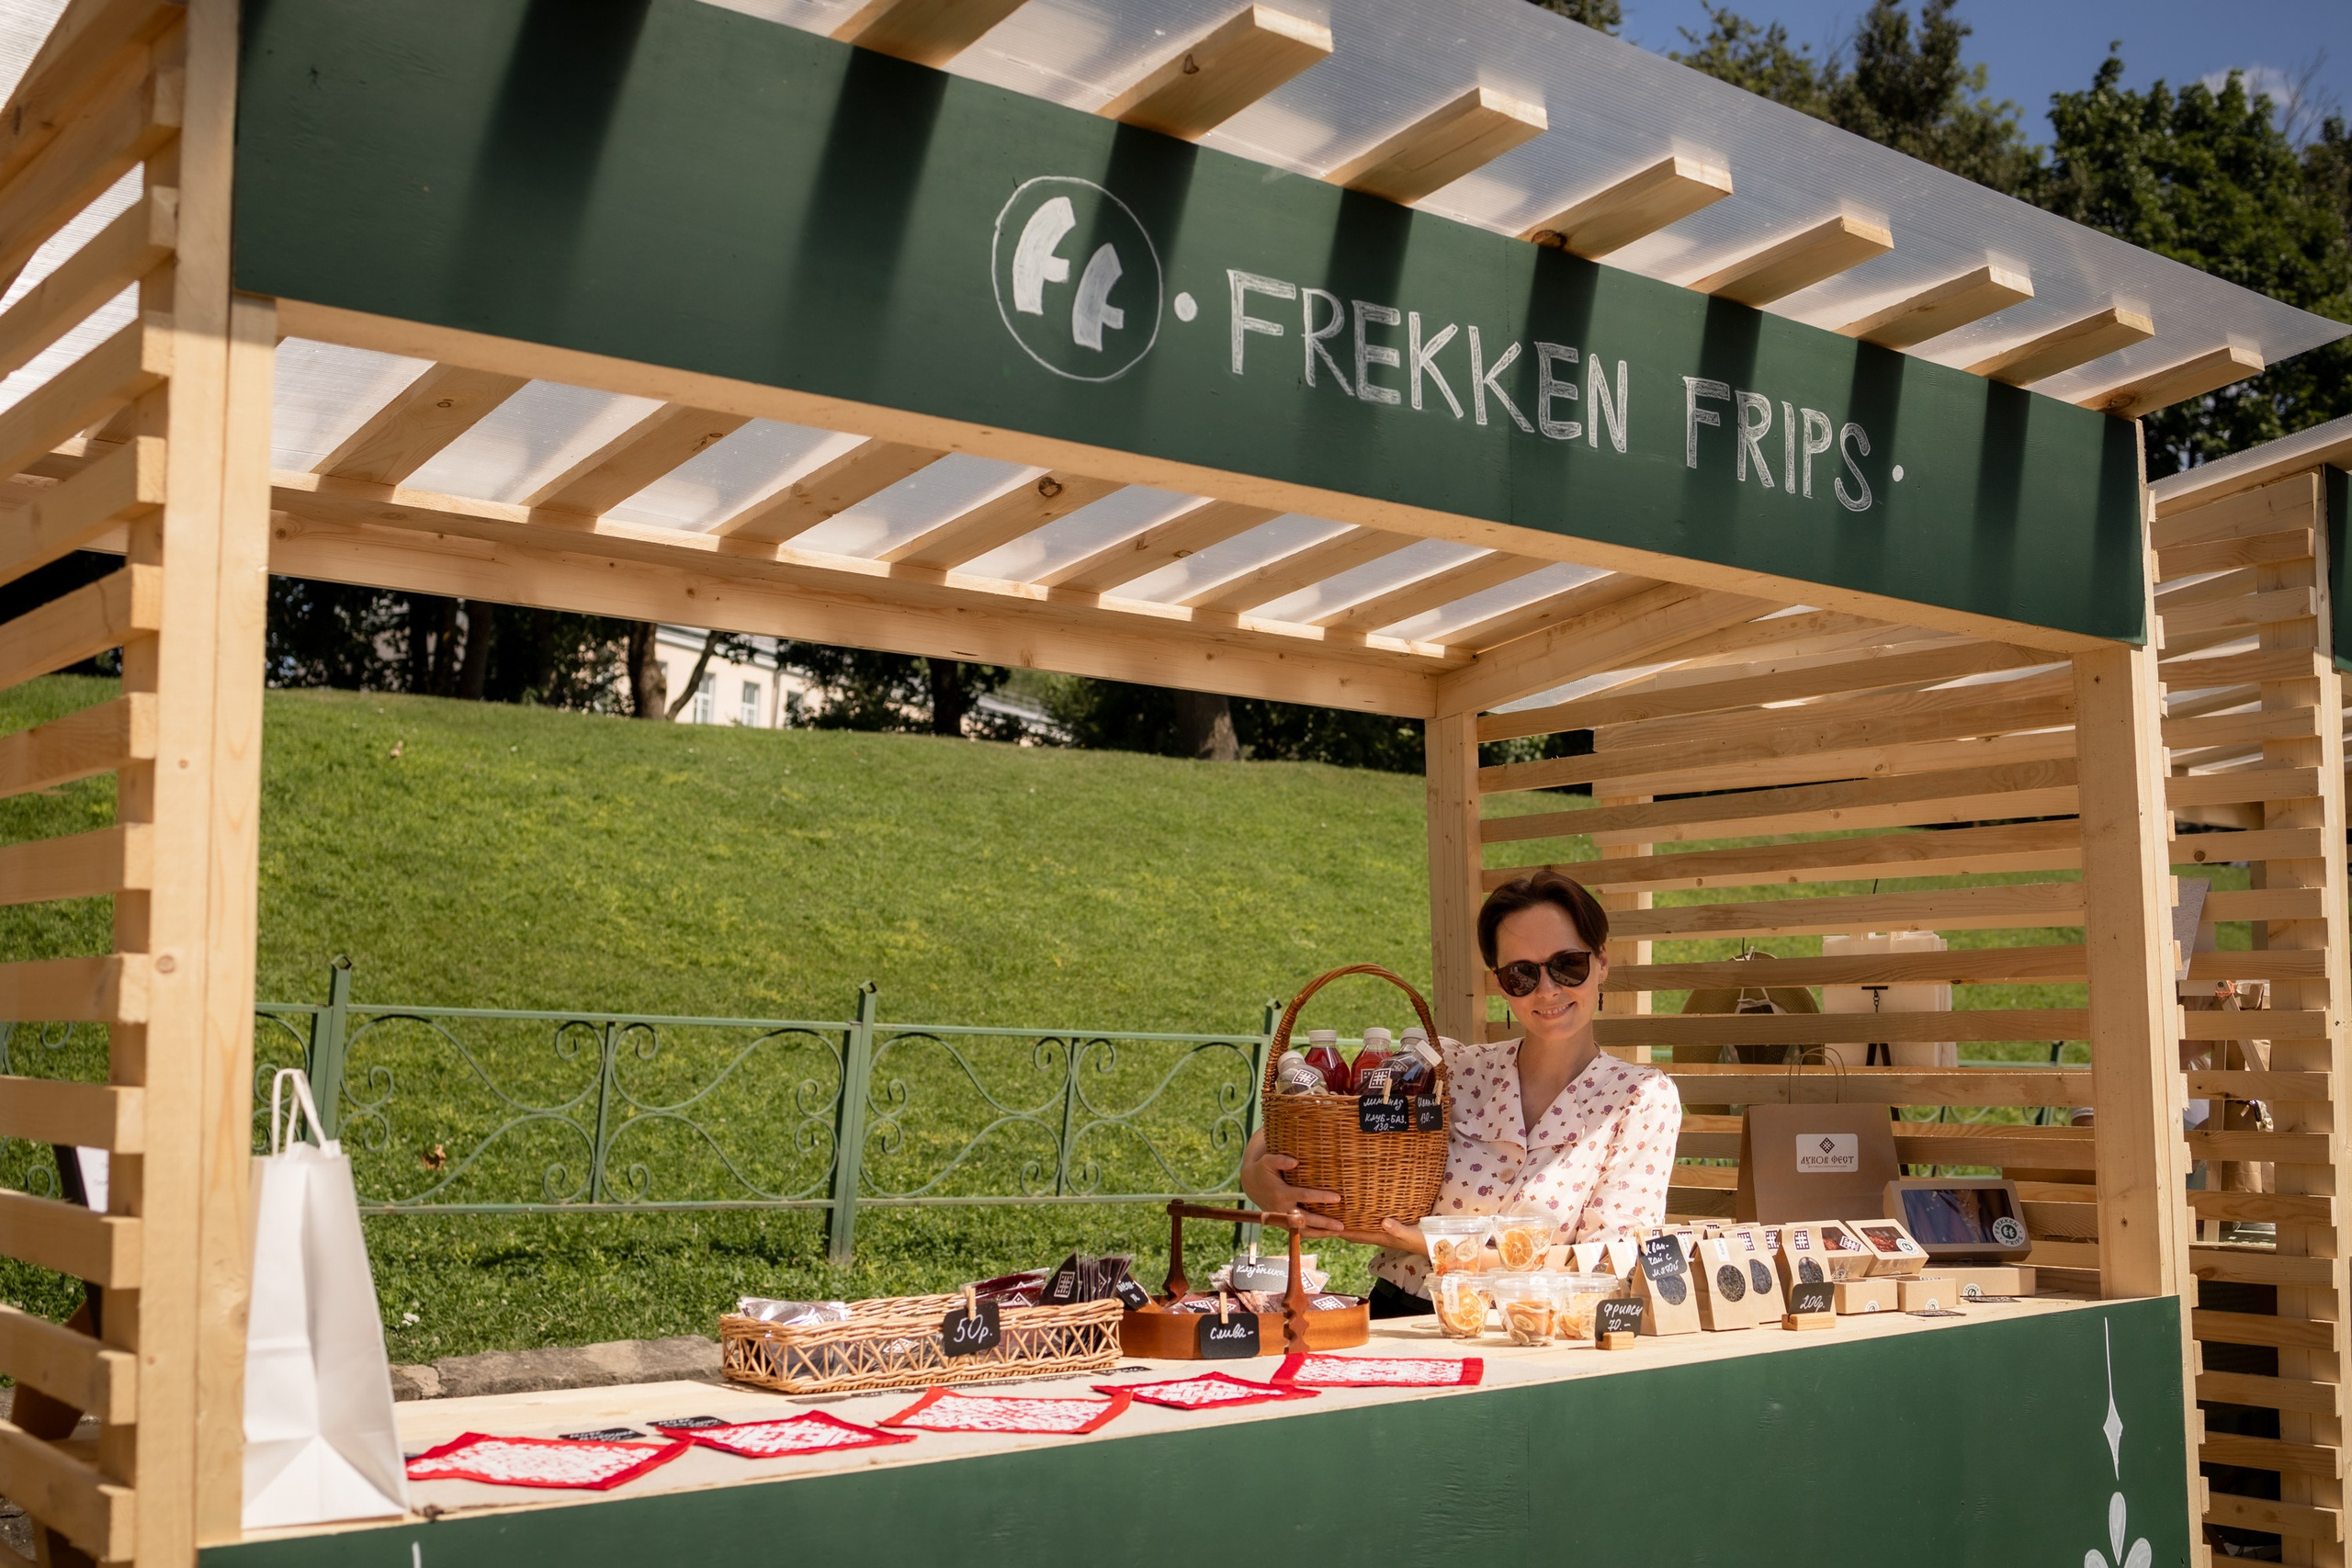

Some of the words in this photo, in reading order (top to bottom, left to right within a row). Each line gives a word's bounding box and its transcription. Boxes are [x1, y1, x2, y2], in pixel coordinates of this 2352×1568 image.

[1227, 268, 1628, 453] FREKKEN
[1682, 376, 1872, 512] FRIPS
[1995, 1218, 2019, 1235] FREKKEN
[2005, 1235, 2023, 1246] FRIPS
[953, 1314, 992, 1344] 50р.
